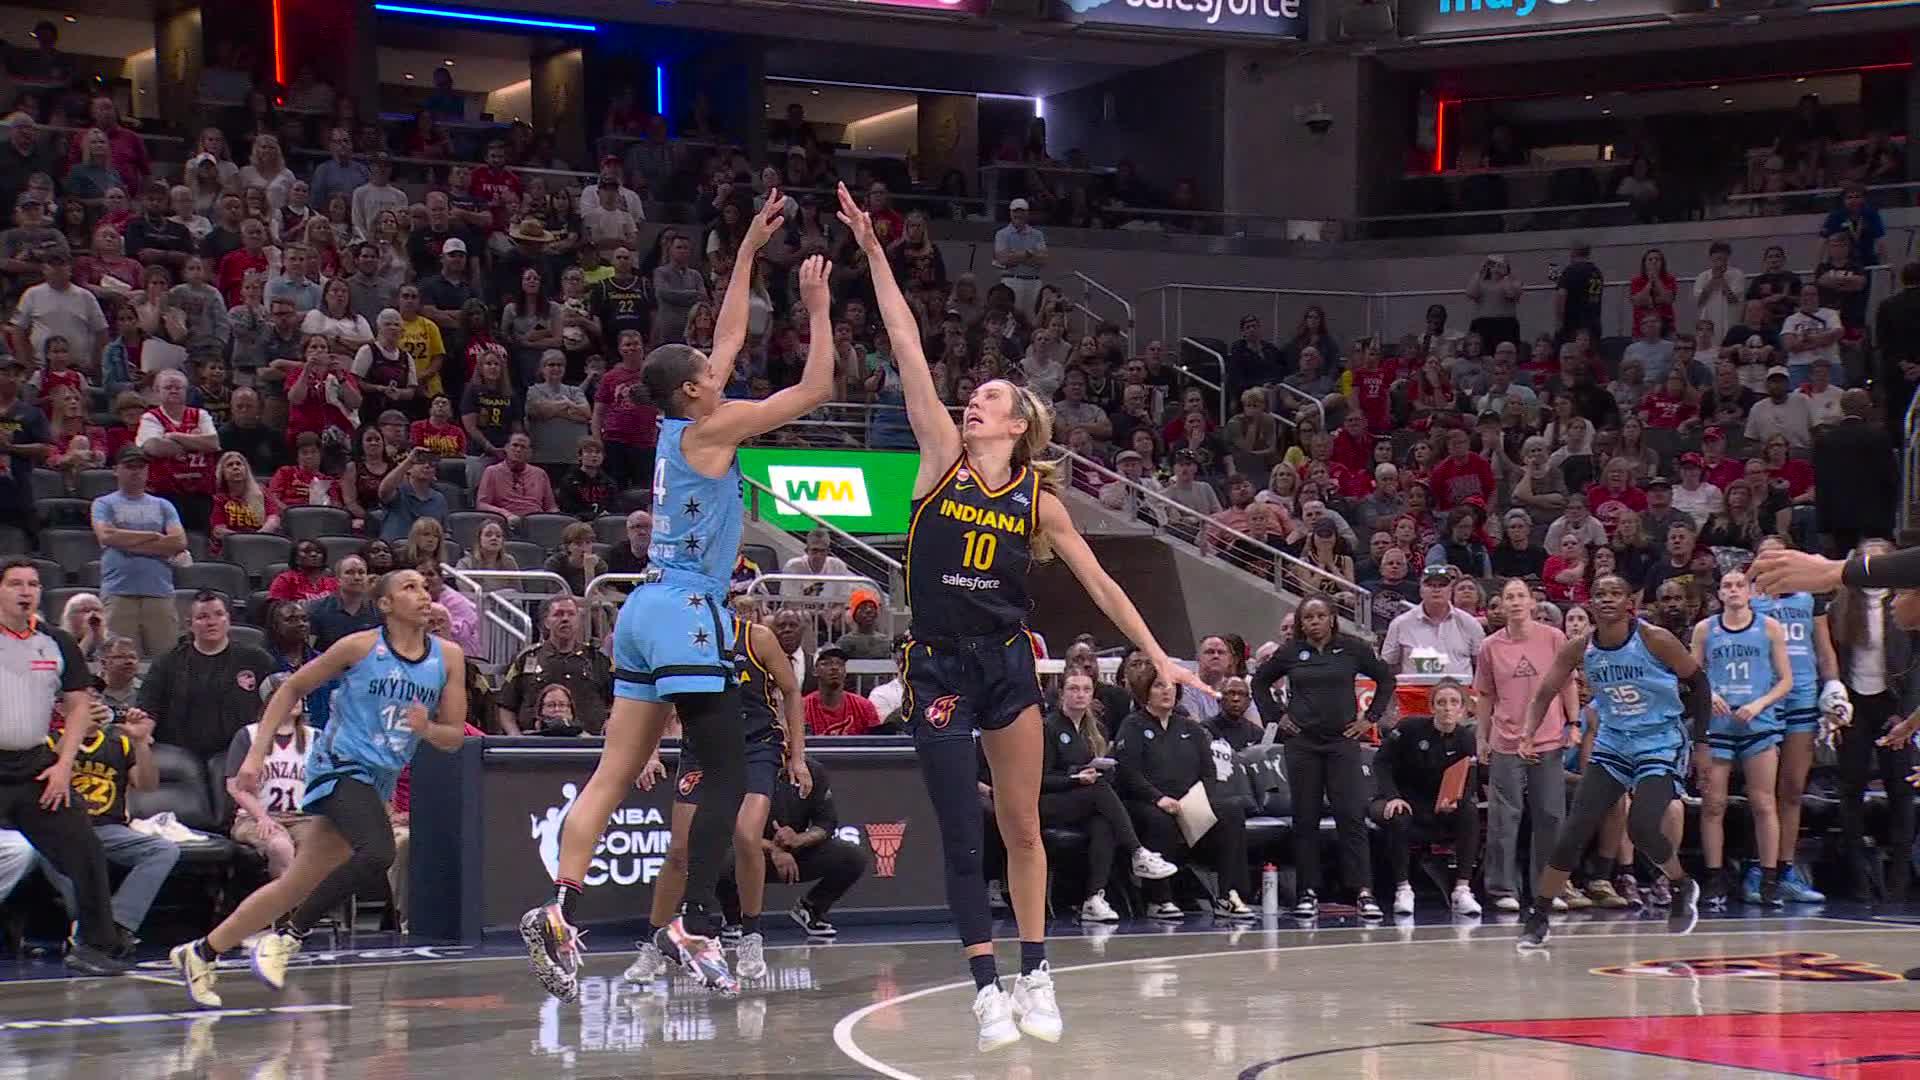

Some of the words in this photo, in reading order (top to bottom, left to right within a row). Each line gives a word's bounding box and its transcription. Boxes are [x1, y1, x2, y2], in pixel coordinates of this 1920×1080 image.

[653, 457, 668, 506] 4
[785, 479, 857, 502] WM
[941, 499, 1025, 535] INDIANA
[963, 530, 997, 571] 10
[943, 572, 1000, 591] salesforce
[1711, 643, 1761, 659] SKYTOWN
[1725, 661, 1750, 680] 11
[258, 761, 306, 782] ONZA
[266, 785, 298, 812] 21
